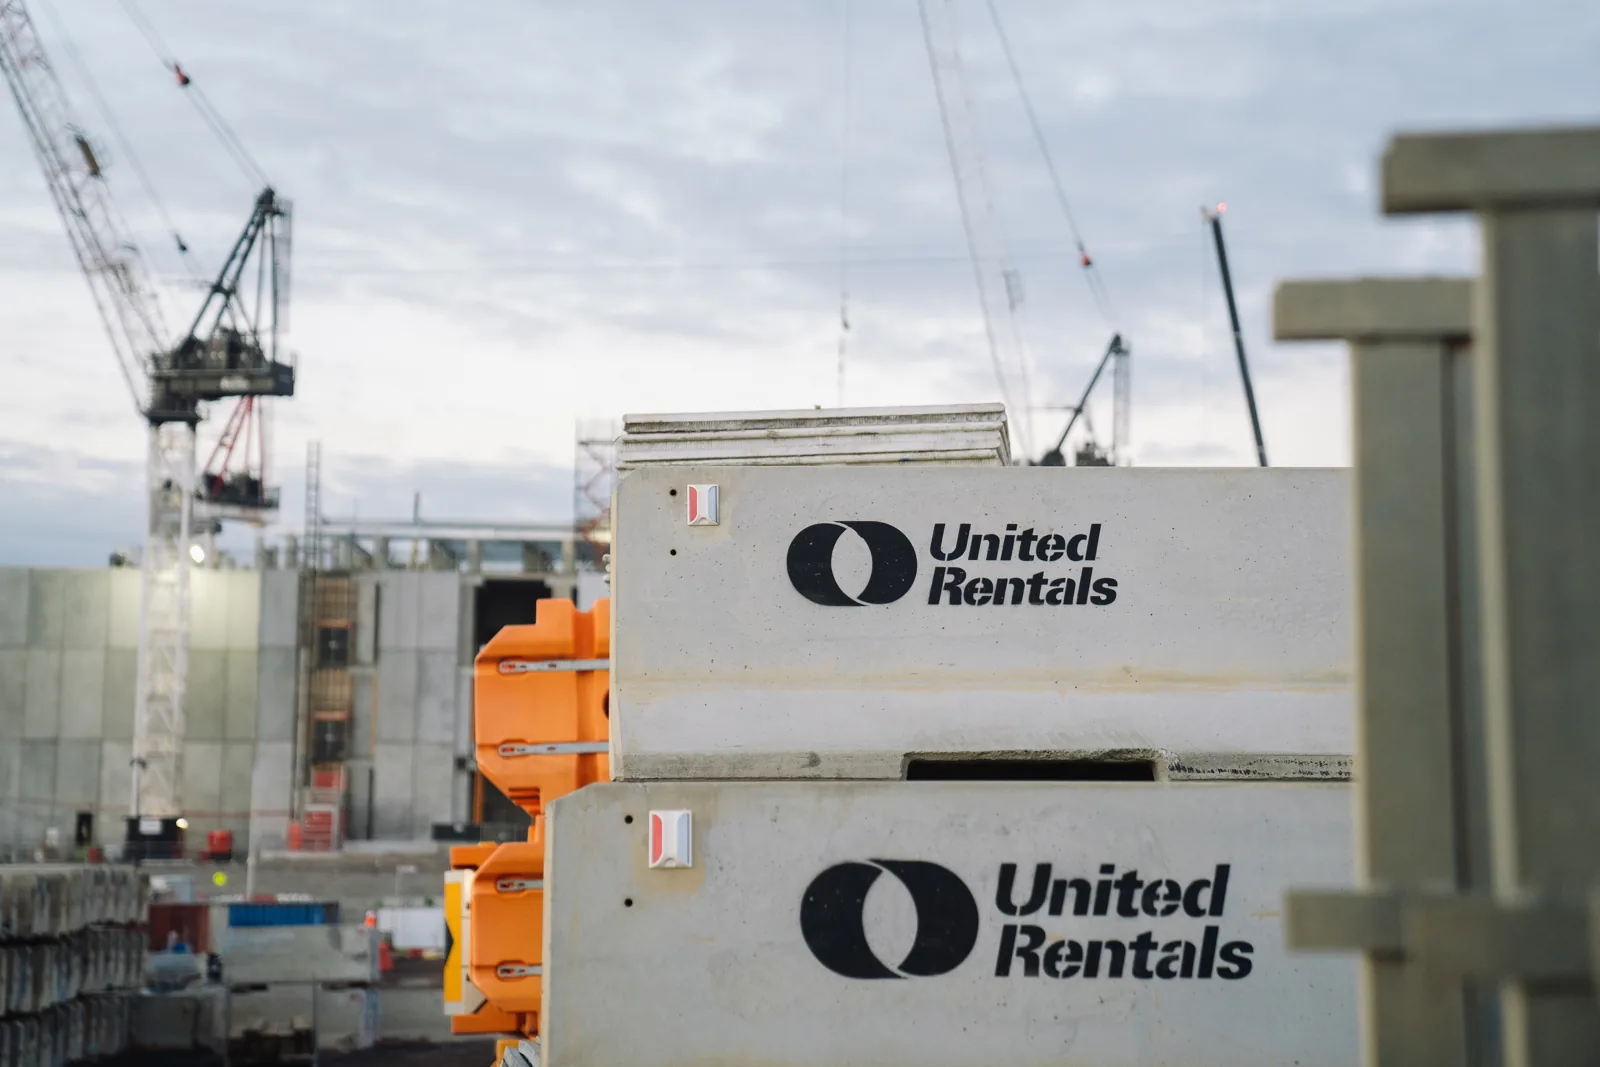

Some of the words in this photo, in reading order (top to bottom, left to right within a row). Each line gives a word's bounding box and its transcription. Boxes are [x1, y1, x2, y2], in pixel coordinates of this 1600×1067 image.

[930, 523, 1101, 562] United
[928, 567, 1118, 606] Rentals
[996, 863, 1231, 919] United
[995, 924, 1254, 981] Rentals
